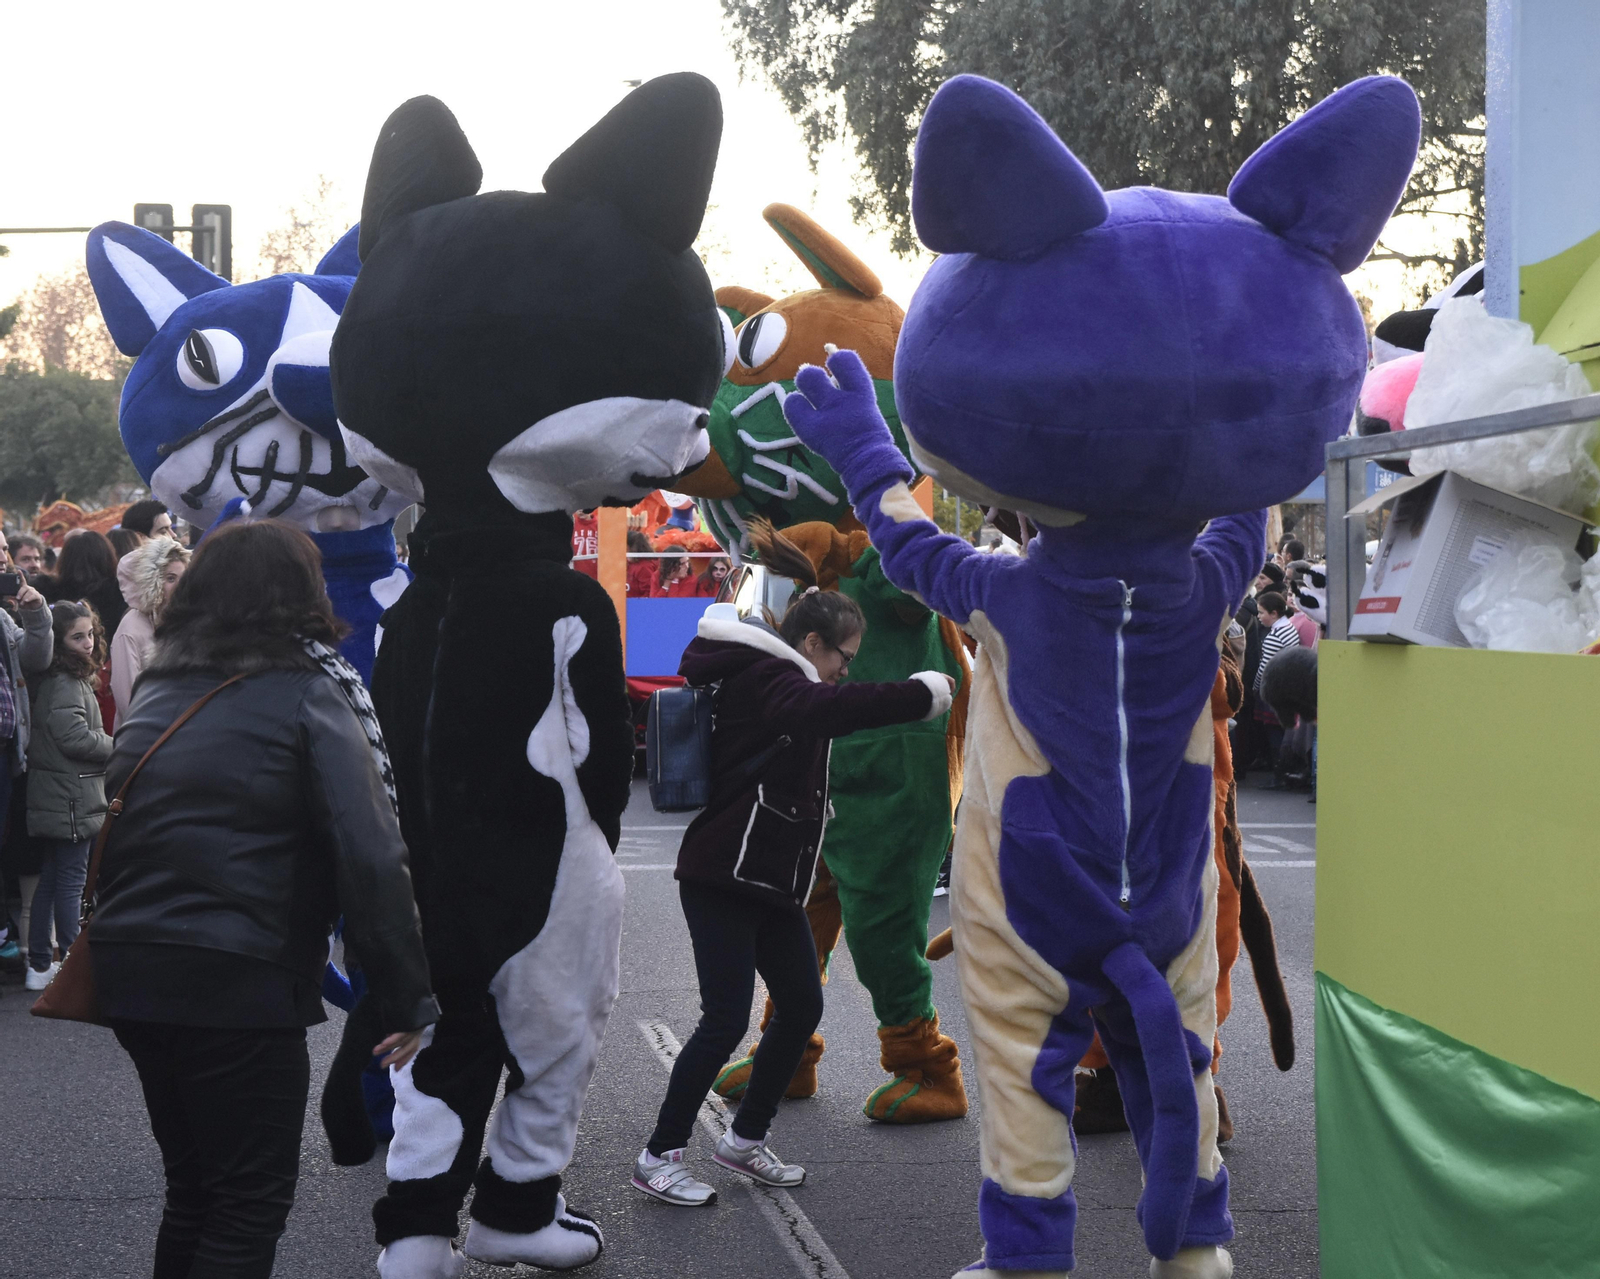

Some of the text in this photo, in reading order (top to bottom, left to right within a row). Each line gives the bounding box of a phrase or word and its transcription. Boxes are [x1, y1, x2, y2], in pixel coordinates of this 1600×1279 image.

[574, 536, 598, 556] 76
[747, 1157, 768, 1171] N
[652, 1174, 672, 1190] N
